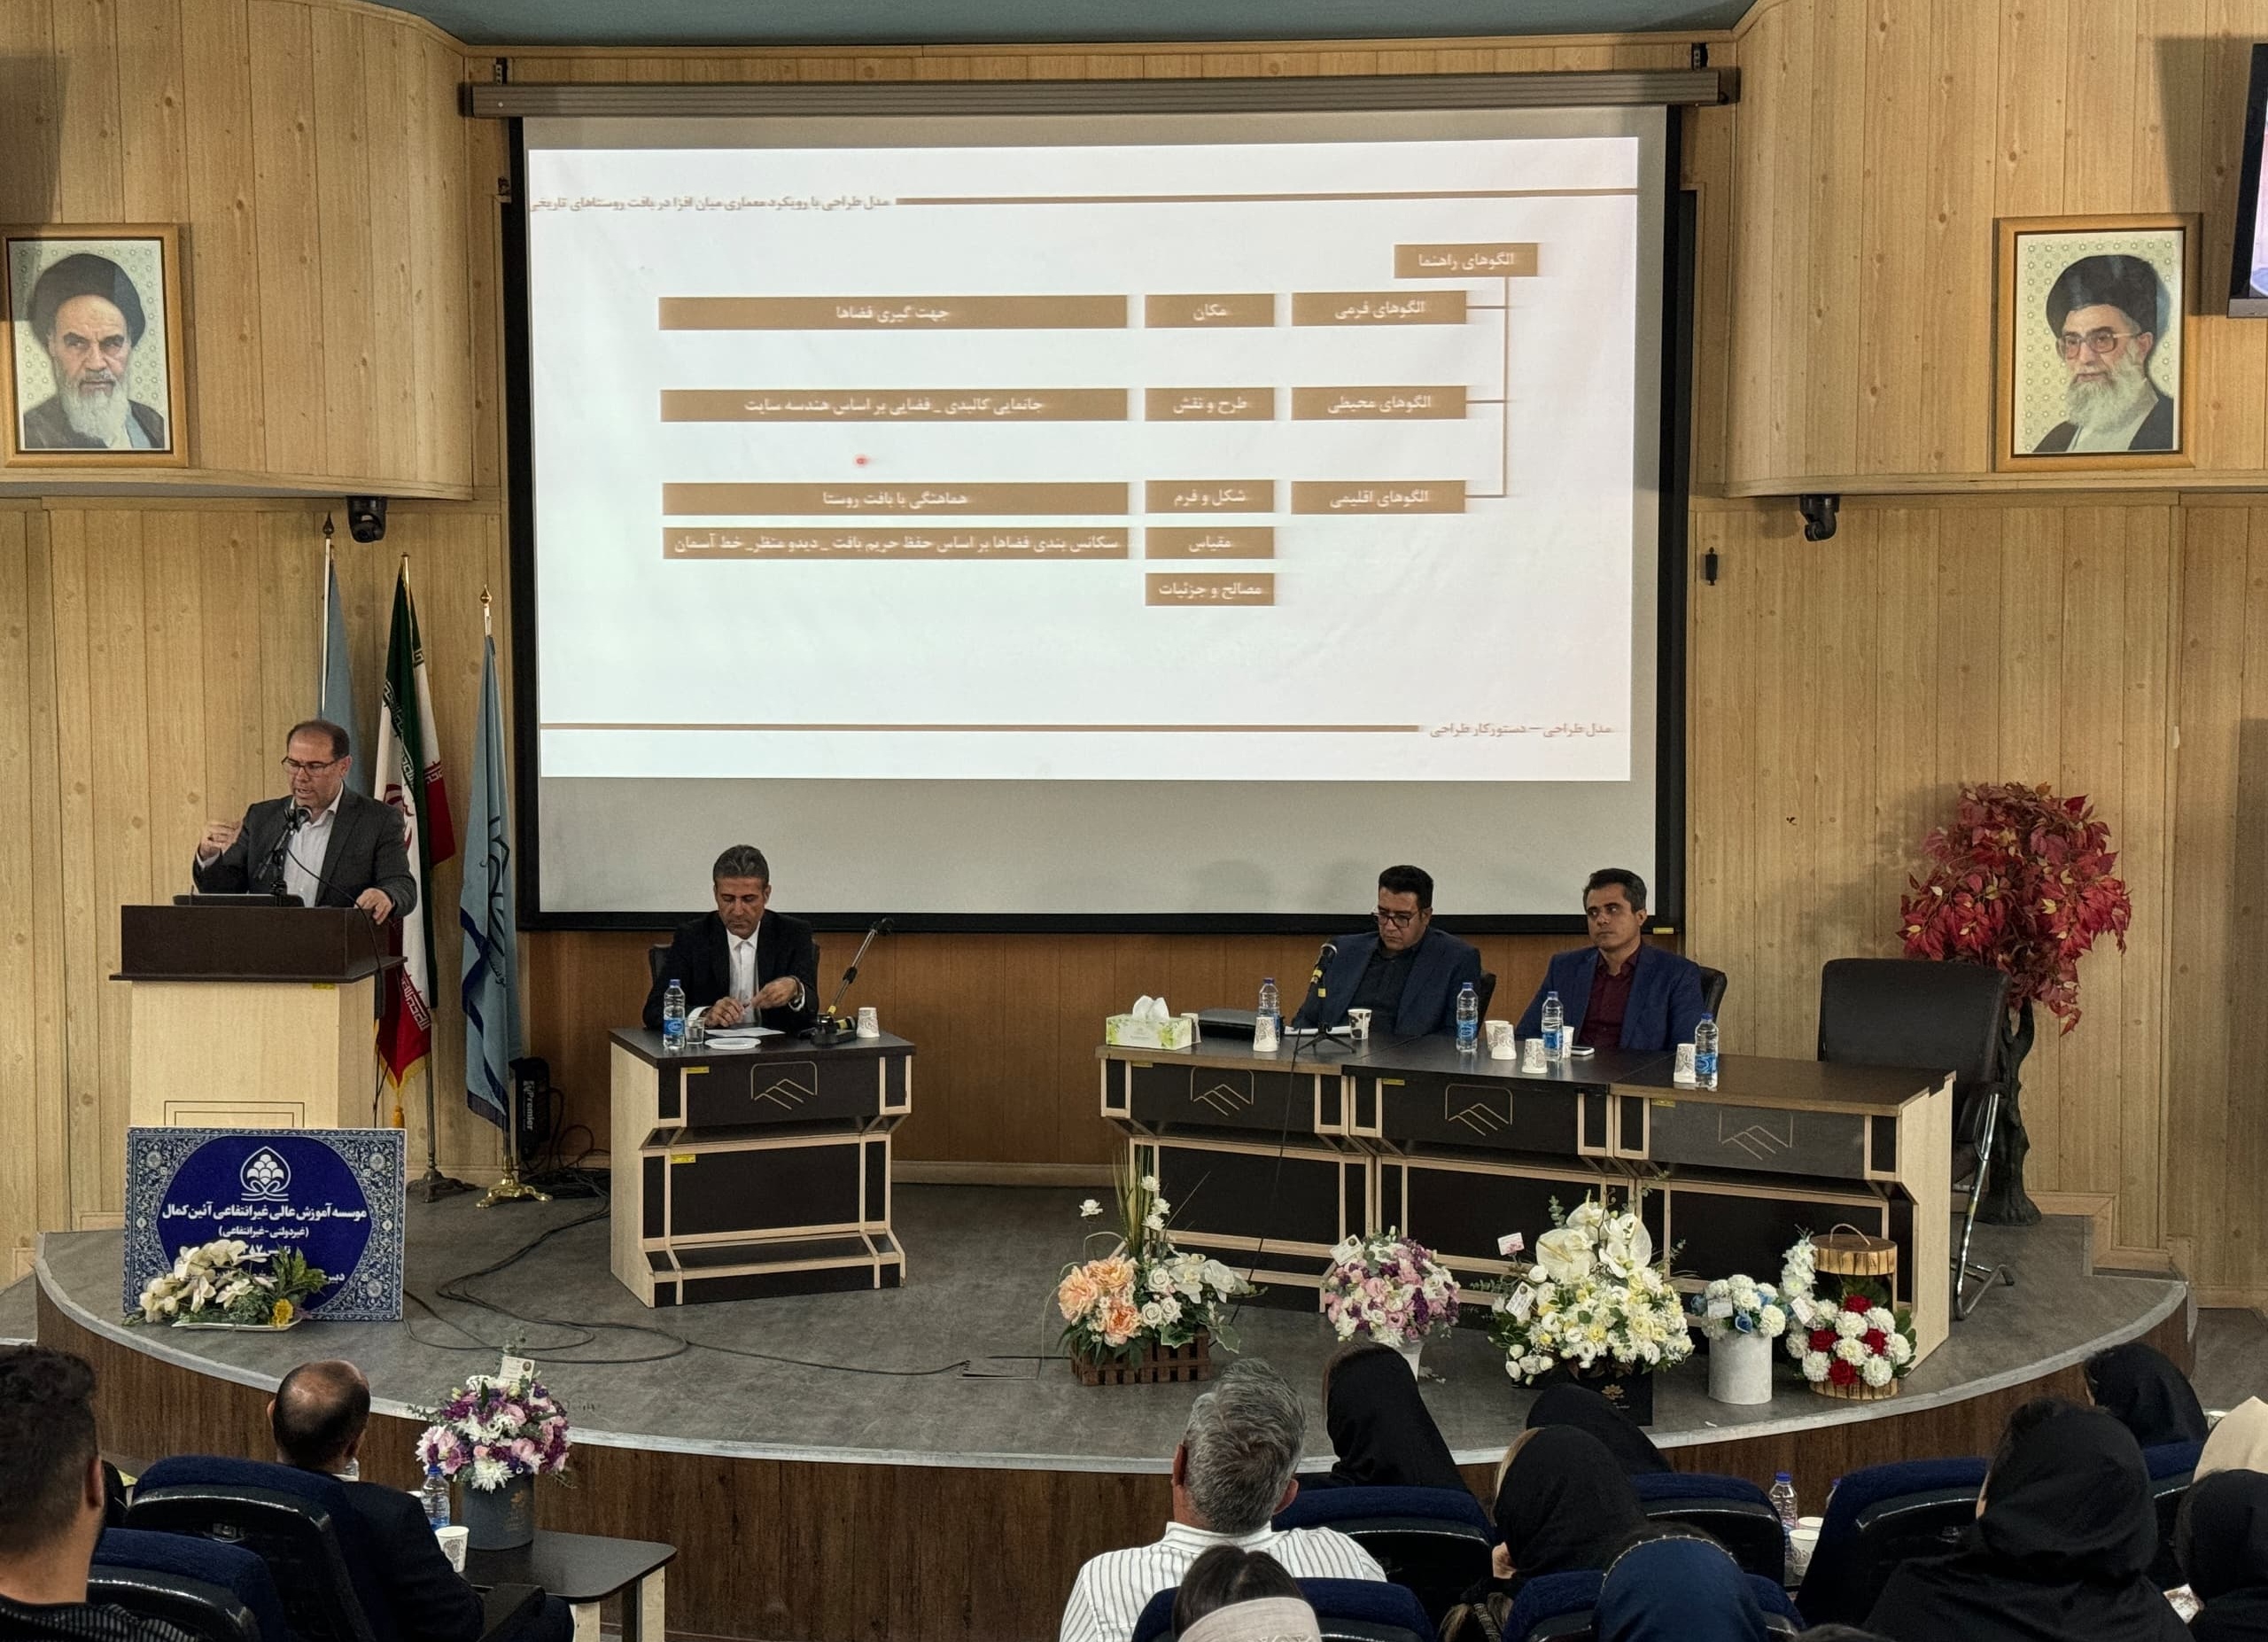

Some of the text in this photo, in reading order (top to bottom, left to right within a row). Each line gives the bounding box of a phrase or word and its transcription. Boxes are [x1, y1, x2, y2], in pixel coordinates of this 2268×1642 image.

[570, 196, 625, 212] روستاهای
[627, 196, 655, 211] بافت
[657, 199, 672, 211] در
[724, 196, 766, 211] معماری
[768, 196, 808, 211] رویکرد
[811, 196, 820, 210] با
[822, 196, 862, 212] طراحی
[863, 196, 889, 211] مدل
[1418, 251, 1515, 271] الگوهای راهنما
[835, 305, 951, 323] جهت گیری فضاها
[1192, 303, 1227, 322] مکان
[1334, 300, 1426, 320] الگوهای فرمی
[744, 398, 781, 415] سایت
[784, 400, 830, 411] هندسه
[832, 397, 871, 416] اساس
[873, 402, 887, 416] بر
[889, 396, 932, 416] فضایی
[944, 397, 991, 415] کالبدی
[1172, 395, 1247, 415] طرح و نقش
[1327, 394, 1432, 414] الگوهای محیطی
[822, 491, 969, 510] هماهنگی با بافت روستا
[1174, 488, 1247, 507] شکل و فرم
[1330, 488, 1429, 509] الگوهای اقلیمی
[674, 533, 716, 553] آسمان
[718, 535, 744, 549] خط
[832, 534, 863, 549] بافت
[864, 540, 899, 553] حریم
[902, 535, 934, 549] حفظ
[936, 535, 975, 553] اساس
[977, 540, 990, 553] بر
[992, 535, 1030, 549] فضاها
[1033, 537, 1067, 553] بندی
[1069, 535, 1120, 553] سکانس
[1188, 535, 1232, 553] مقیاس
[1210, 587, 1219, 598] و
[1221, 581, 1262, 600] مصالح
[1430, 723, 1471, 738] طراحی
[1543, 723, 1584, 738] طراحی
[1586, 723, 1612, 737] مدل
[161, 1203, 190, 1219] کمال
[213, 1203, 269, 1220] غیرانتفاعی
[268, 1204, 296, 1221] عالی
[296, 1202, 334, 1221] آموزش
[331, 1208, 368, 1222] موسسه
